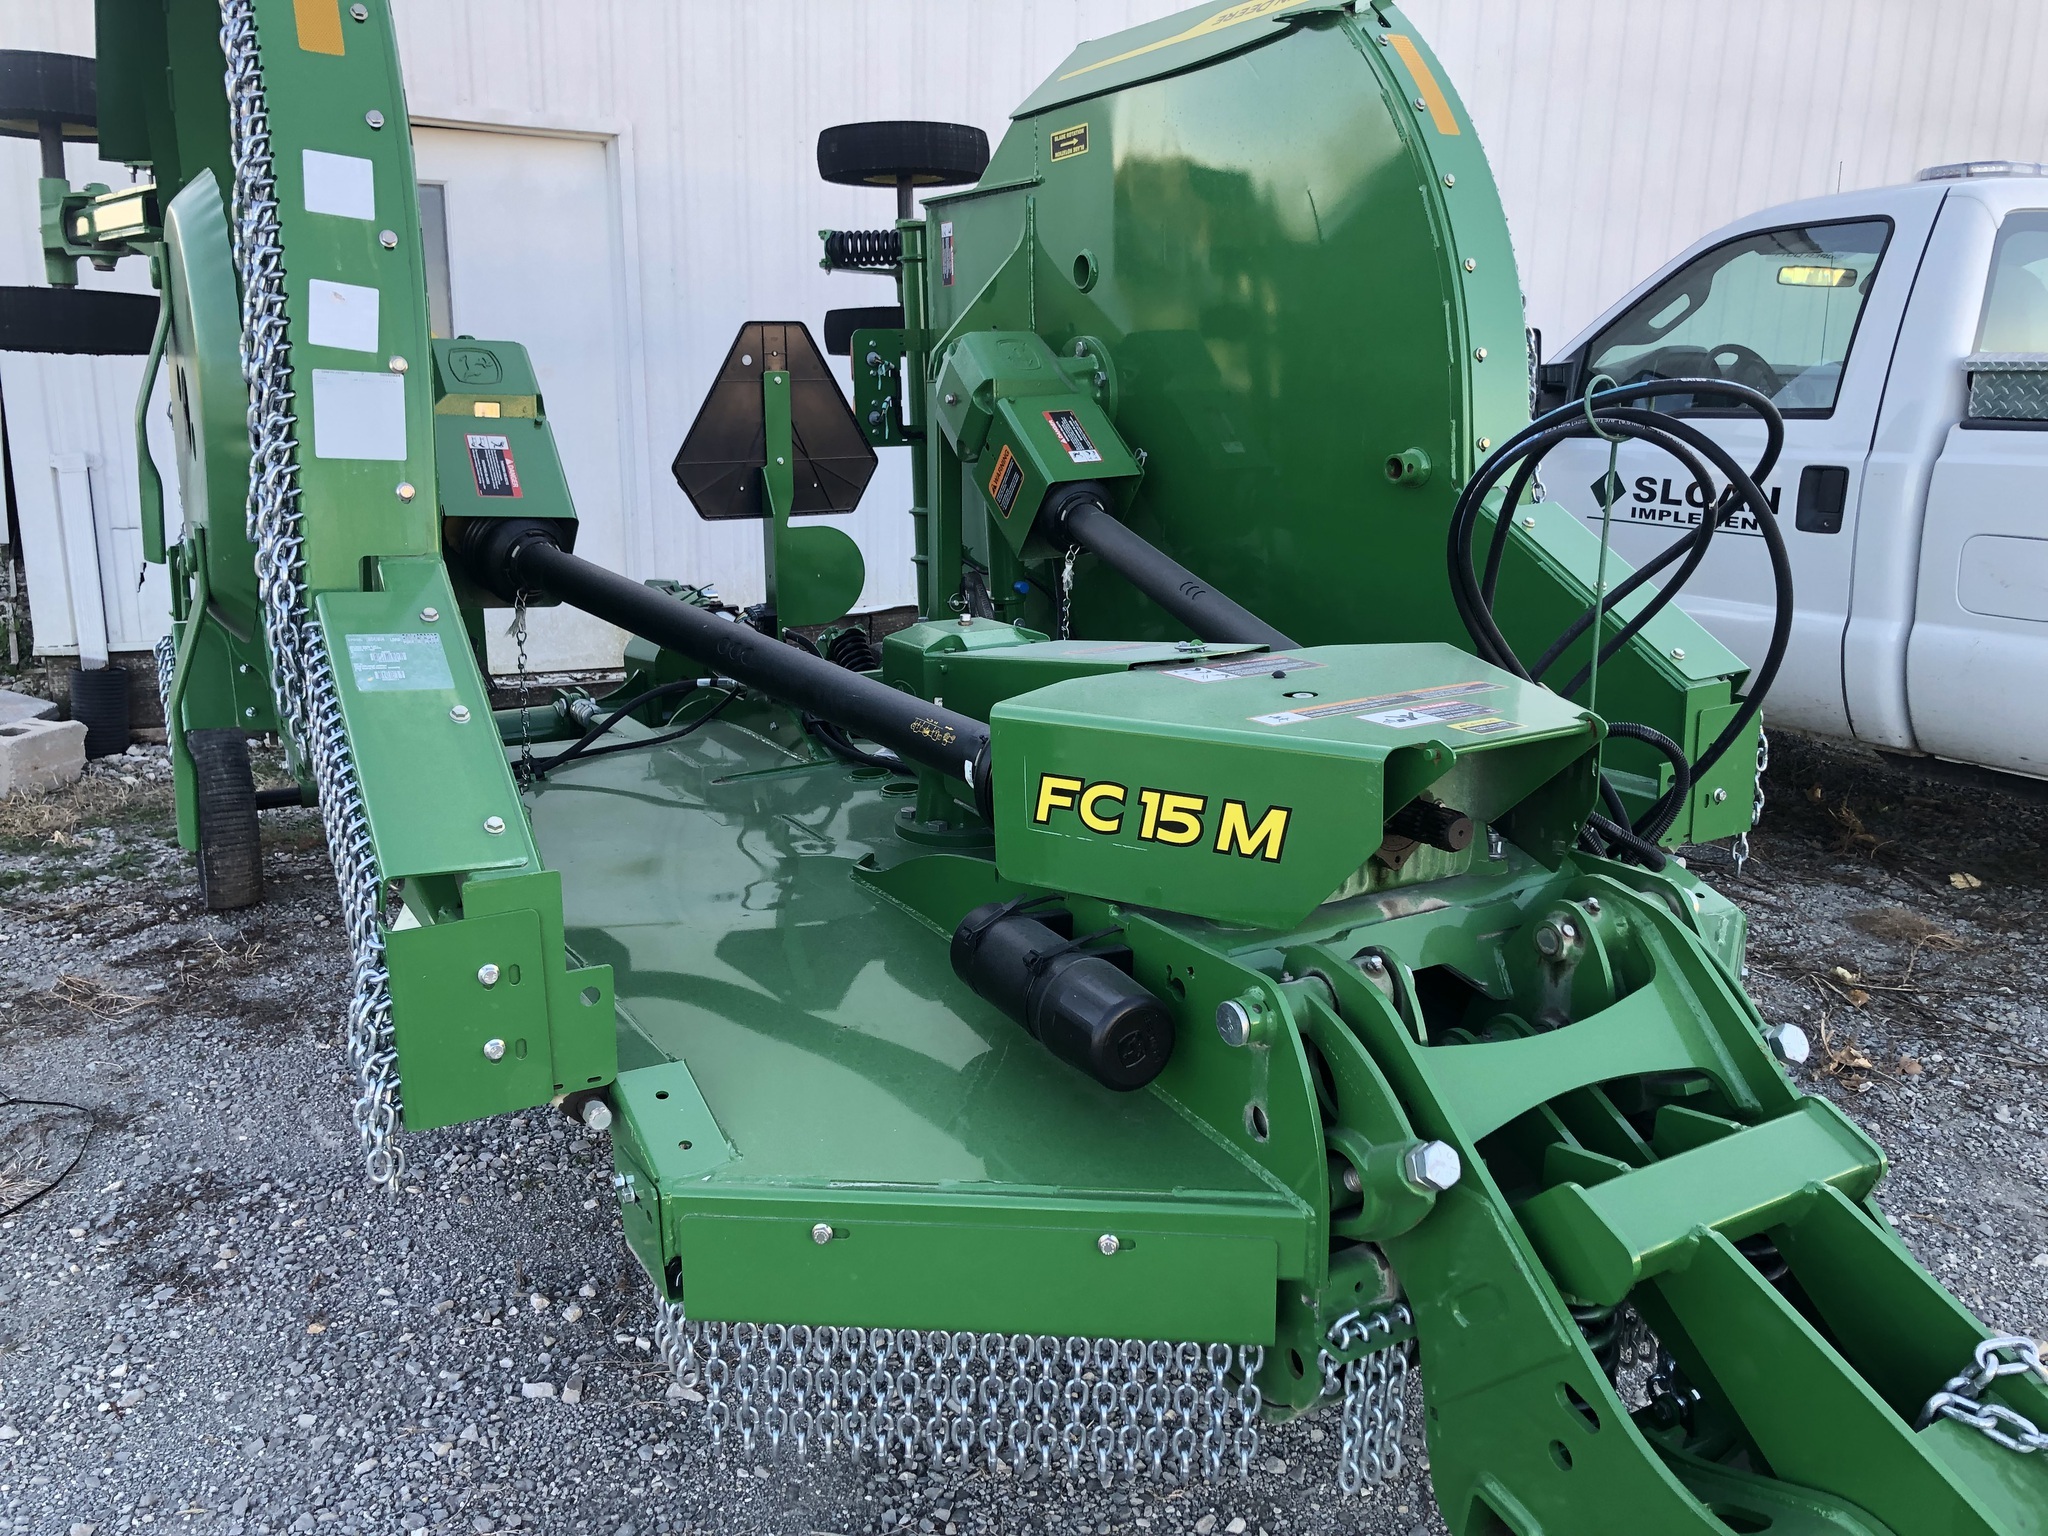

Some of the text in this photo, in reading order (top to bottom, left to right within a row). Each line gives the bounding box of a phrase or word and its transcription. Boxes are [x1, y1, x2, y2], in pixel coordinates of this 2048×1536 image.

[1211, 0, 1274, 26] DEERE
[507, 464, 519, 488] DANGER
[993, 448, 1011, 487] WARNING
[1033, 772, 1293, 864] FC 15 M
